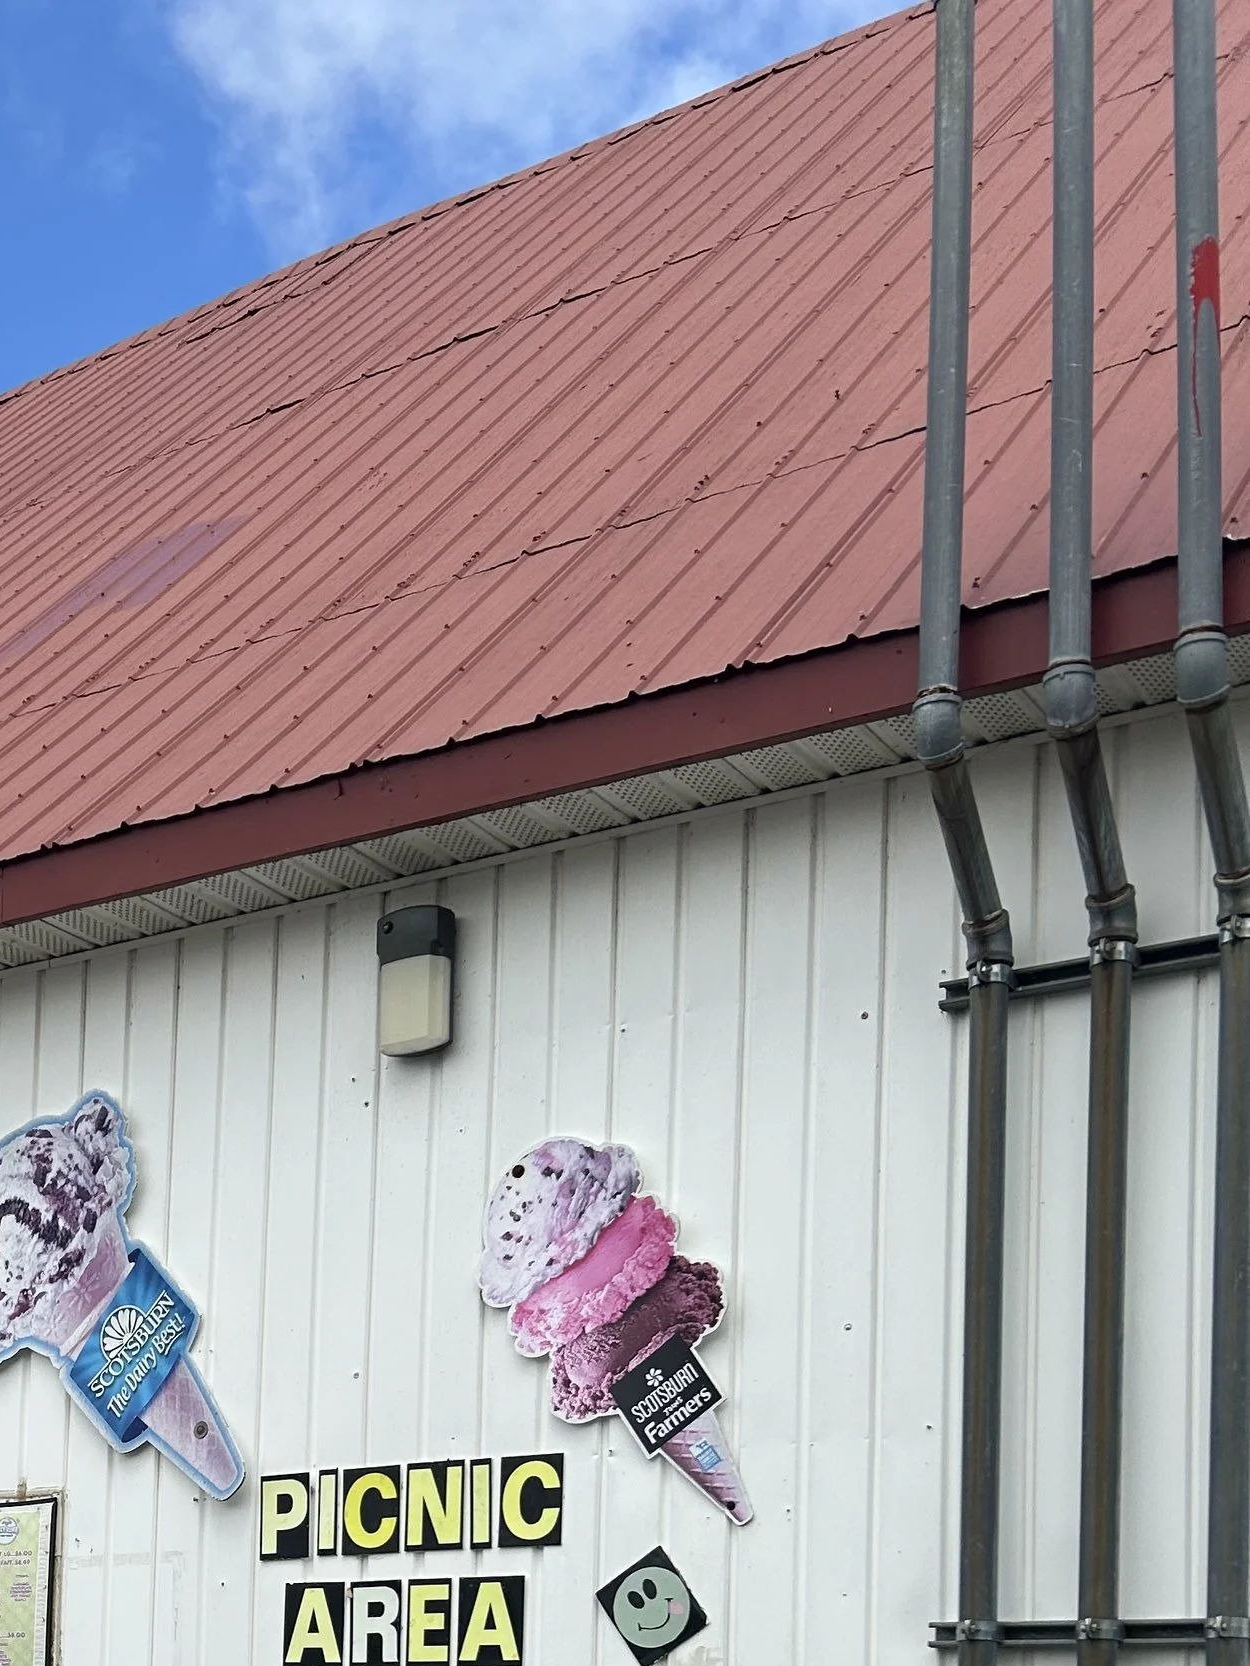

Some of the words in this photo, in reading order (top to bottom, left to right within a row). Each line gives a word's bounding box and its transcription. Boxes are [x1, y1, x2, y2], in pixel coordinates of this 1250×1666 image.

[90, 1292, 175, 1398] SCOTSBURN
[107, 1385, 131, 1418] The
[127, 1347, 157, 1391] Dairy
[153, 1312, 186, 1354] Best!
[630, 1362, 699, 1424] SCOTSBURN
[643, 1386, 712, 1444] Farmers
[261, 1460, 561, 1555] PICNIC
[284, 1582, 520, 1664] AREA
